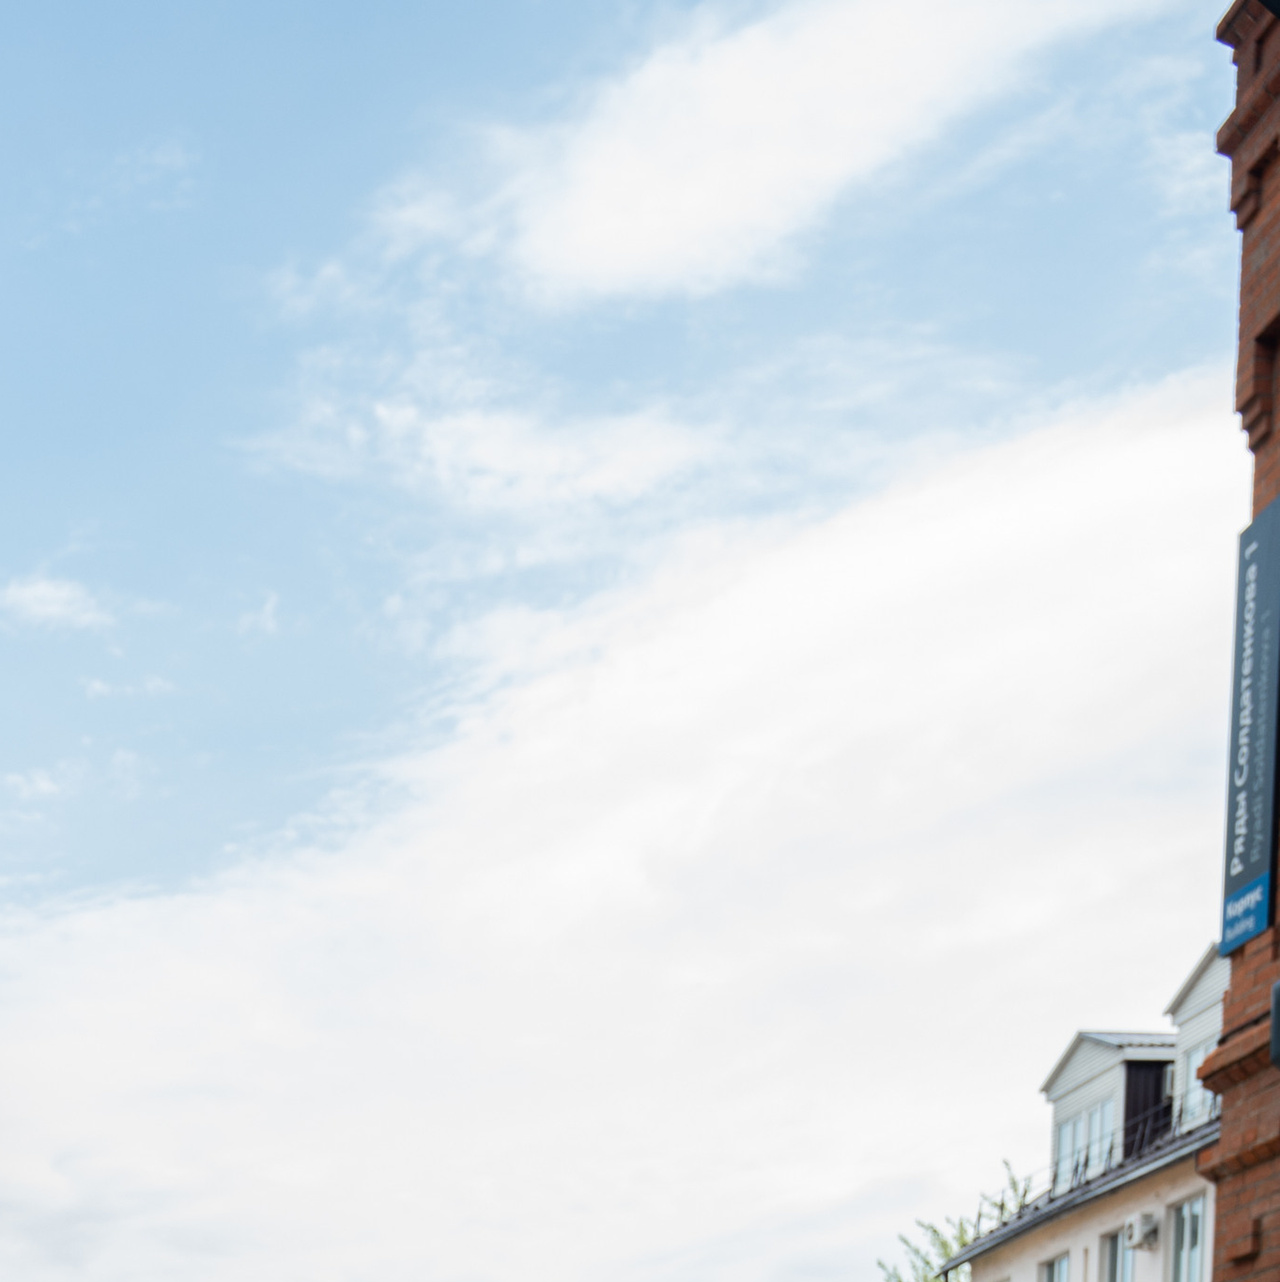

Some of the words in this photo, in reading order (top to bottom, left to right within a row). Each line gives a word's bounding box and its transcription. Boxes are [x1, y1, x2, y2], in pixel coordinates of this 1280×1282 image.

[1244, 540, 1259, 561] 1
[1234, 563, 1258, 787] Солдатенкова
[1230, 790, 1248, 877] Ряды
